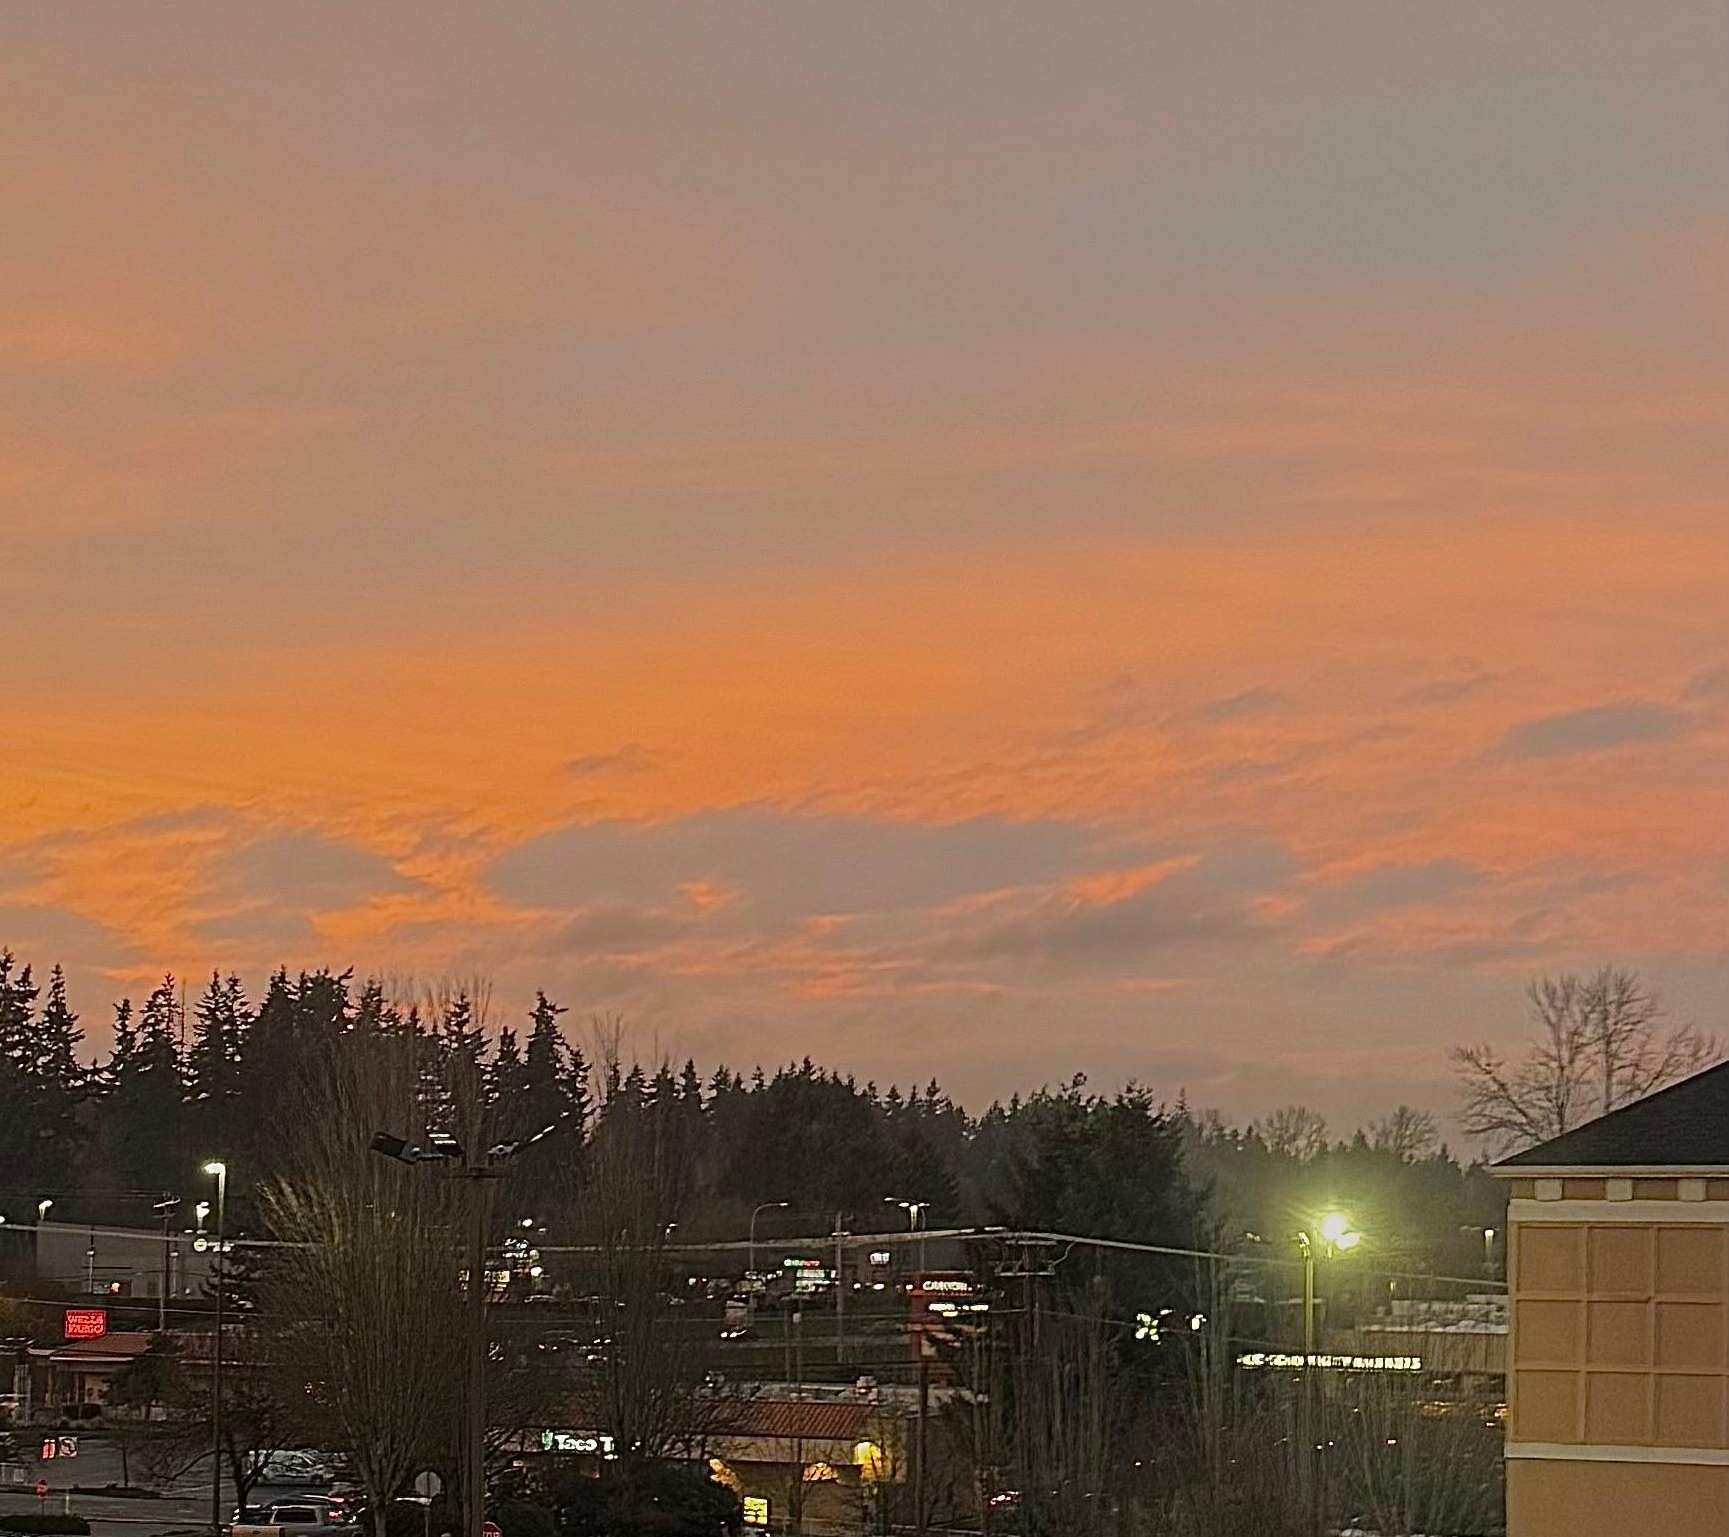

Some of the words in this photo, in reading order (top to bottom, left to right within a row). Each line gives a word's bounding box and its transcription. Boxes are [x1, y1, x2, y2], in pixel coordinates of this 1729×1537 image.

[68, 1315, 104, 1324] WELLS
[68, 1324, 104, 1334] FARGO
[555, 1434, 598, 1451] Taco
